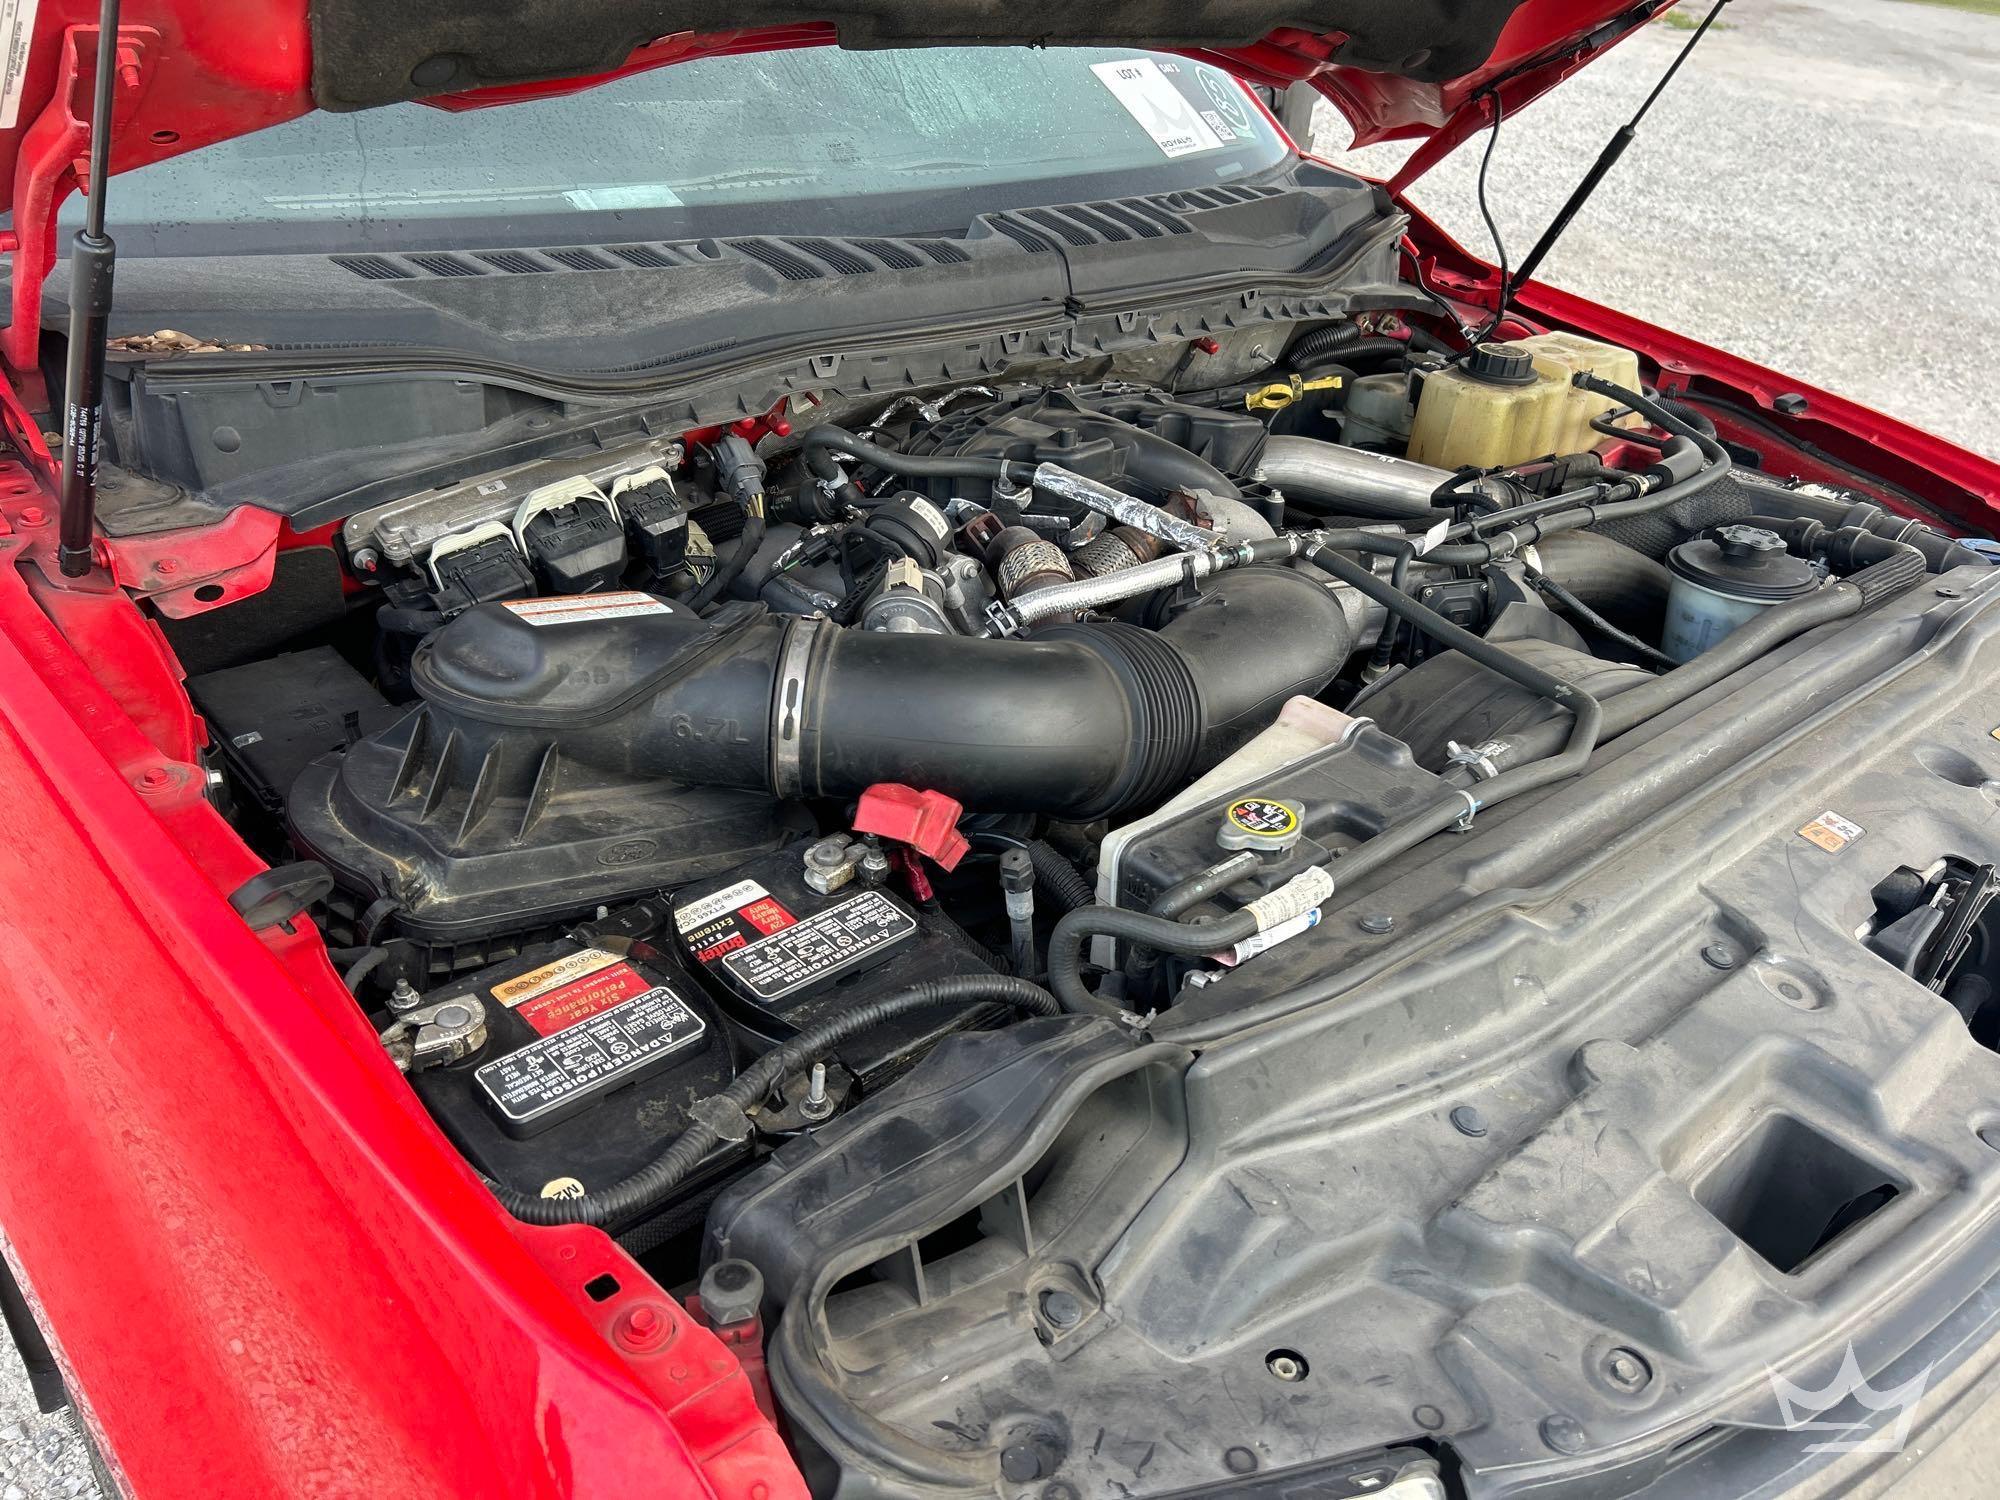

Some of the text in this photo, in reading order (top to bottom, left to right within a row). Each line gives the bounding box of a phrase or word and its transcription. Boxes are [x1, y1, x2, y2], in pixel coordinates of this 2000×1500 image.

[1116, 67, 1136, 81] LOT
[1160, 138, 1186, 149] ROYAL
[670, 712, 752, 746] 6.7L
[746, 901, 770, 915] Duty
[750, 905, 779, 922] Heavy
[759, 912, 782, 926] Very
[767, 918, 786, 930] 12V
[685, 916, 735, 943] Extreme
[781, 932, 881, 984] DANGER/POISON
[580, 974, 611, 990] Tougher
[544, 979, 629, 1021] Performance
[554, 991, 573, 1001] Last
[565, 992, 622, 1022] Six Year
[622, 1002, 679, 1031] EXPLOSIVE GASES
[626, 1013, 668, 1035] SHIELD EYES
[592, 1023, 616, 1037] FLAMES
[596, 1028, 620, 1041] SPARKS
[605, 1035, 617, 1044] NO
[572, 1055, 606, 1075] SULFURIC
[583, 1051, 602, 1063] ACID
[497, 1063, 516, 1076] FAST
[502, 1070, 521, 1082] HELP
[538, 1038, 662, 1101] DANGER/POISON
[499, 1069, 561, 1102] WATER IMMEDIATELY
[503, 1068, 545, 1090] GET MEDICAL
[510, 1074, 565, 1104] FLUSH EYES WITH
